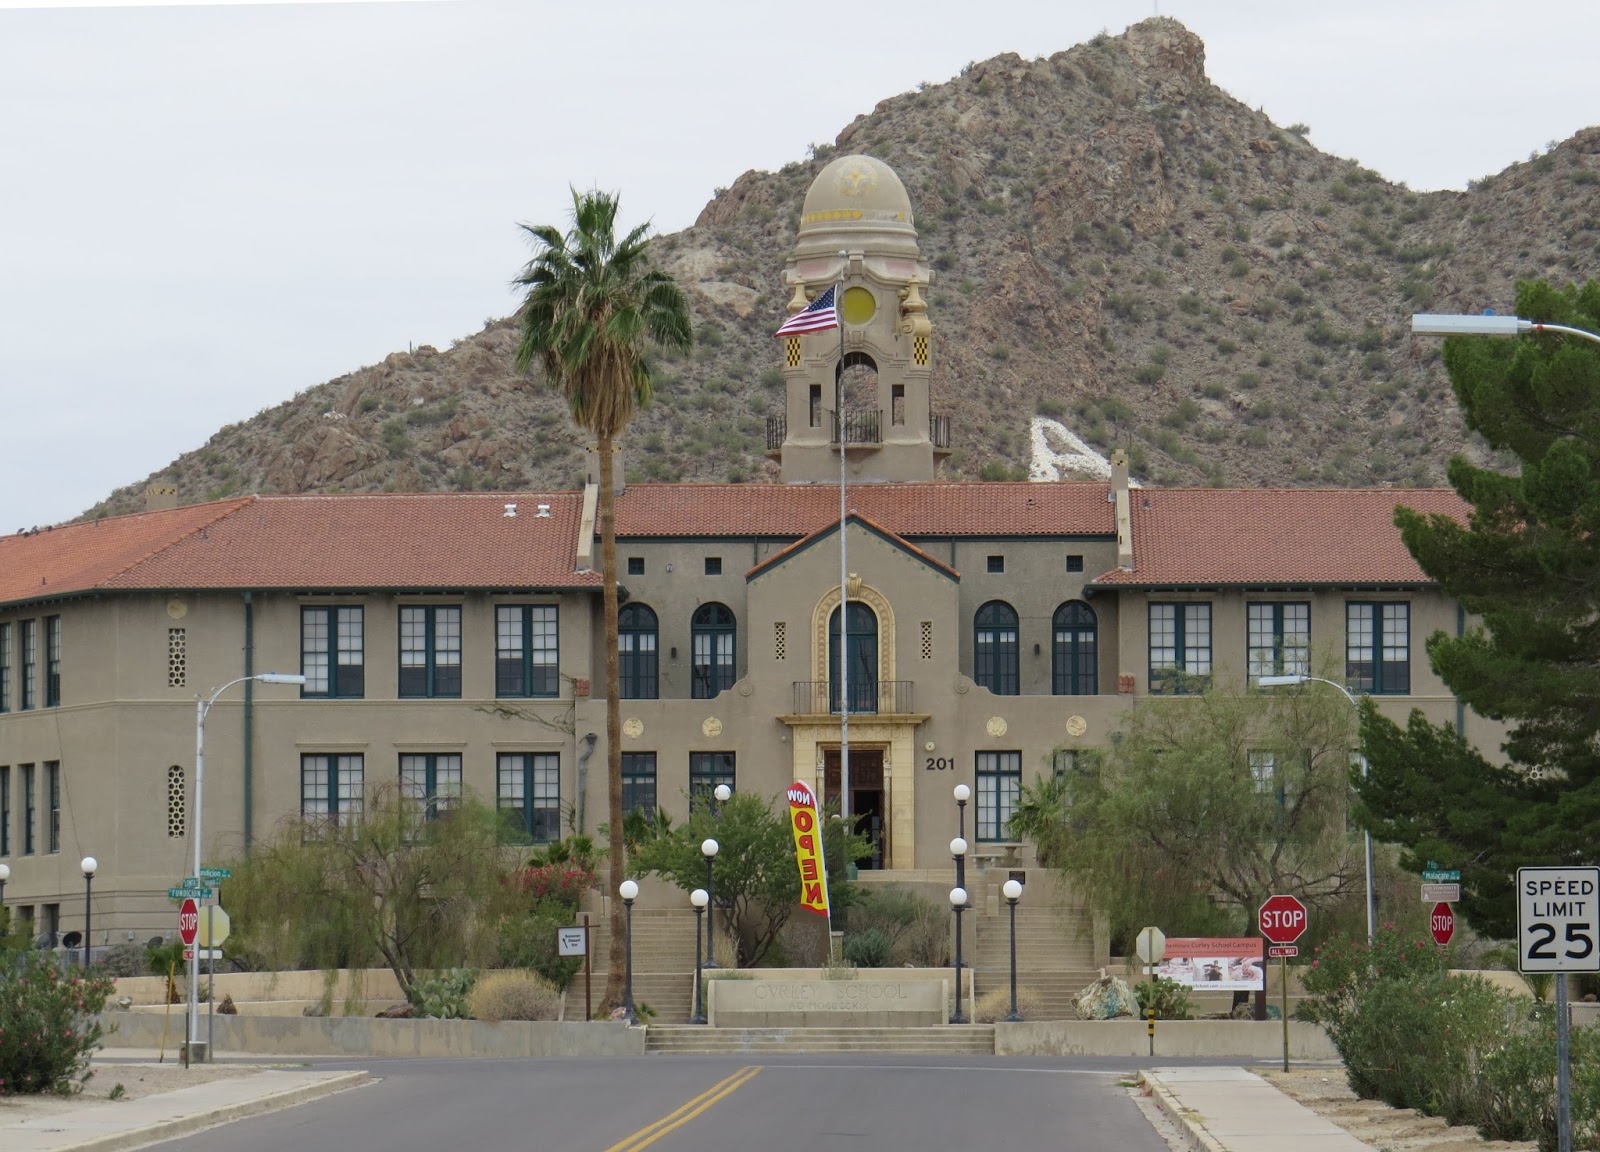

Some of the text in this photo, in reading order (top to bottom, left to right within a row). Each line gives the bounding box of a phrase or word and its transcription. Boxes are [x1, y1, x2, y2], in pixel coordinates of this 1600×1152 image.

[926, 757, 954, 770] 201
[1425, 871, 1450, 880] Malacate
[171, 888, 201, 897] FUNDICION
[1526, 880, 1594, 896] SPEED
[1533, 902, 1586, 917] LIMIT
[181, 913, 197, 930] STOP
[1262, 910, 1303, 929] STOP
[1432, 915, 1453, 931] STOP
[1191, 942, 1211, 950] Curley
[1232, 942, 1257, 950] Campus
[1527, 923, 1594, 959] 25
[836, 983, 908, 1000] SCHOOL
